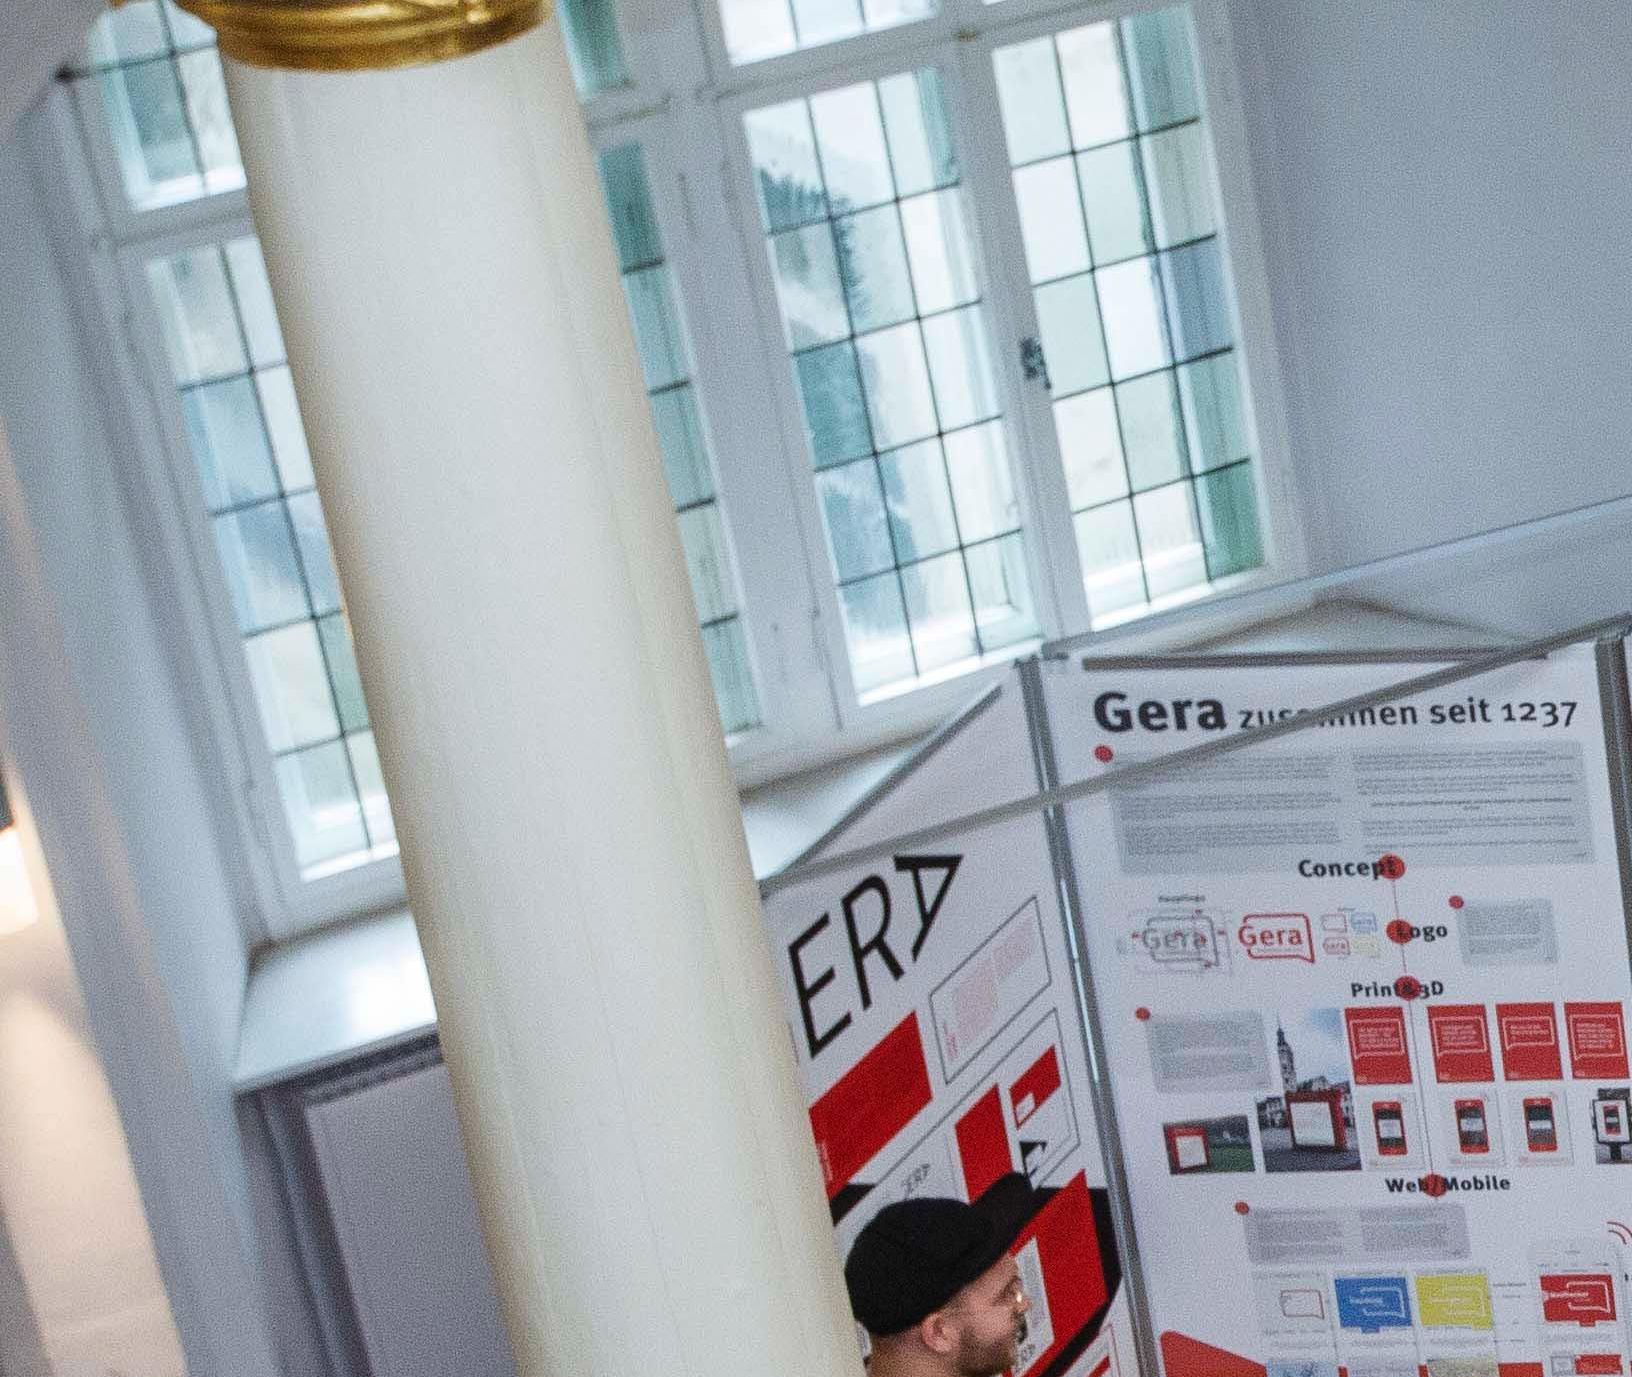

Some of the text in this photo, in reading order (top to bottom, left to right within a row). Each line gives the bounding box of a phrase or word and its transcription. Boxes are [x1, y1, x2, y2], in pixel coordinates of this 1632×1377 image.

[1093, 691, 1227, 734] Gera
[1429, 697, 1493, 728] seit
[1501, 700, 1580, 728] 1237
[1298, 858, 1397, 881] Concept
[1237, 924, 1305, 948] Gera
[788, 853, 964, 1060] ERA
